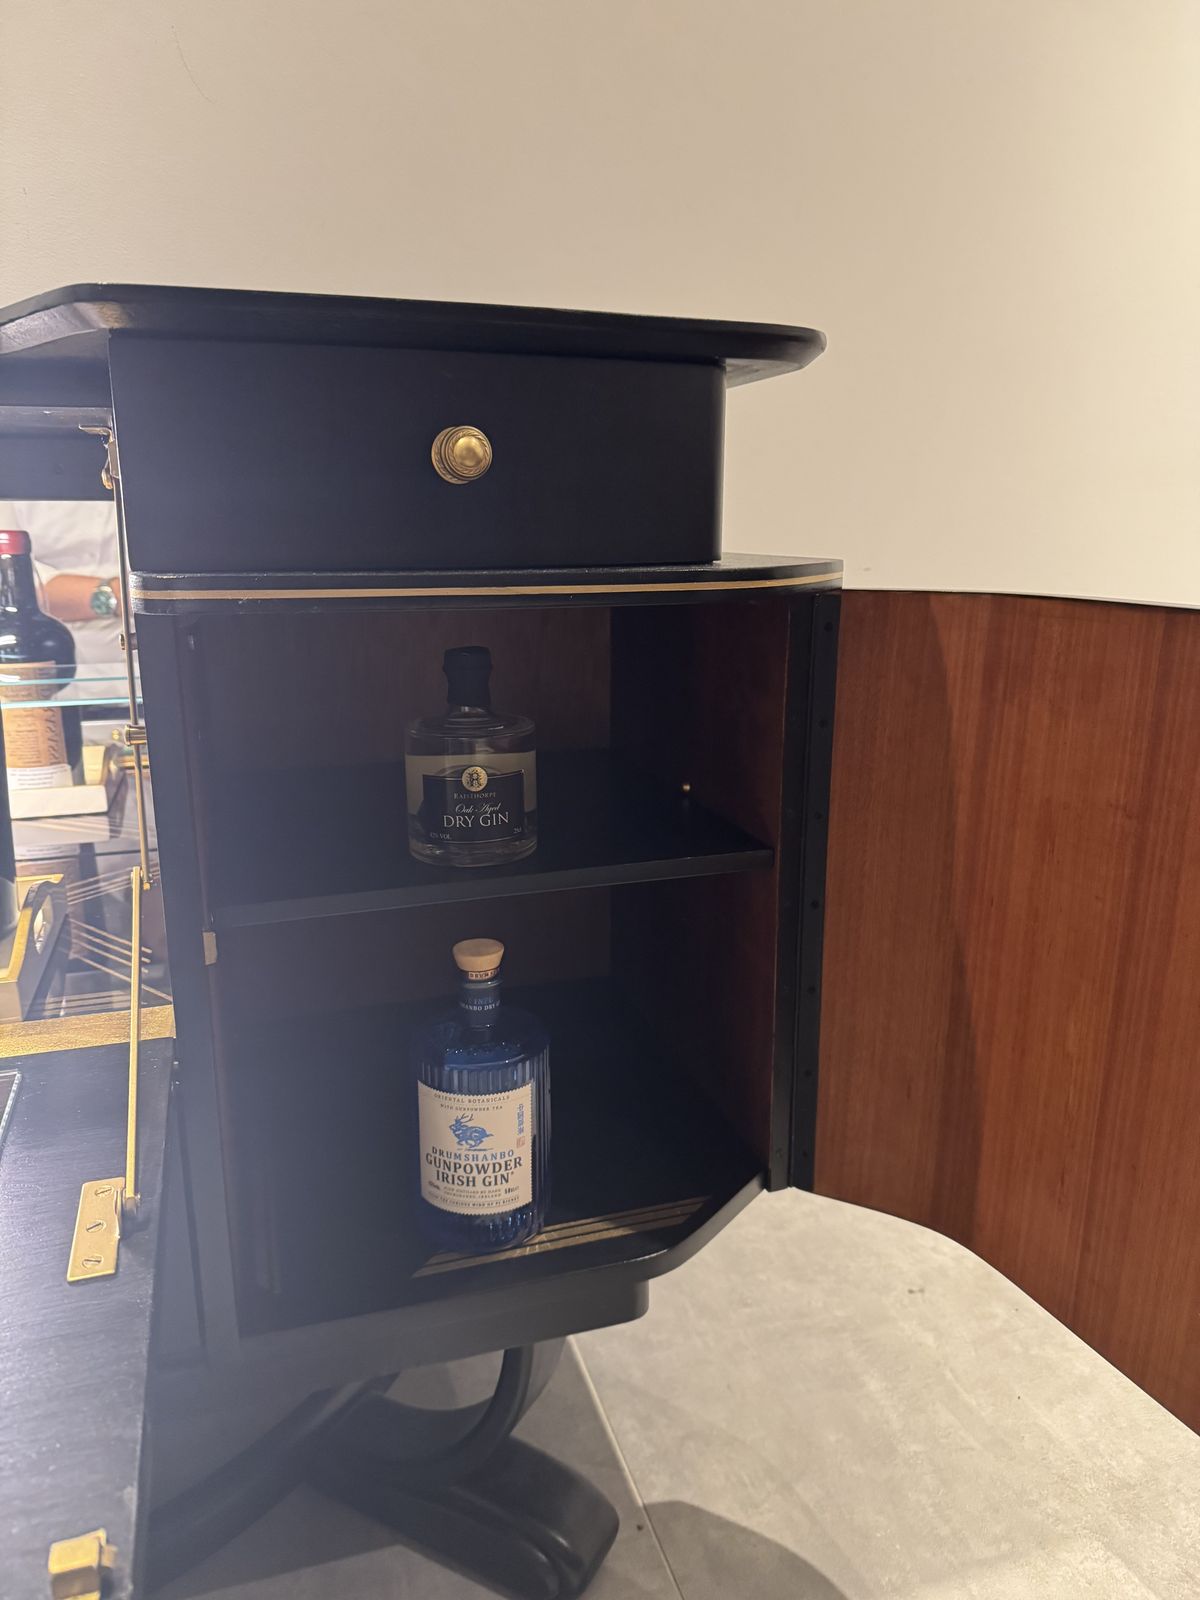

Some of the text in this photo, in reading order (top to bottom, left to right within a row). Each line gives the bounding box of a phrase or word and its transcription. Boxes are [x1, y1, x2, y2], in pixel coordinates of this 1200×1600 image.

[443, 811, 509, 828] DRY GIN
[434, 1093, 510, 1104] ORIENTAL BOTANICALS
[432, 1146, 514, 1162] DRUMSHANBO
[425, 1152, 523, 1175] GUNPOWDER
[436, 1170, 476, 1187] IRISH
